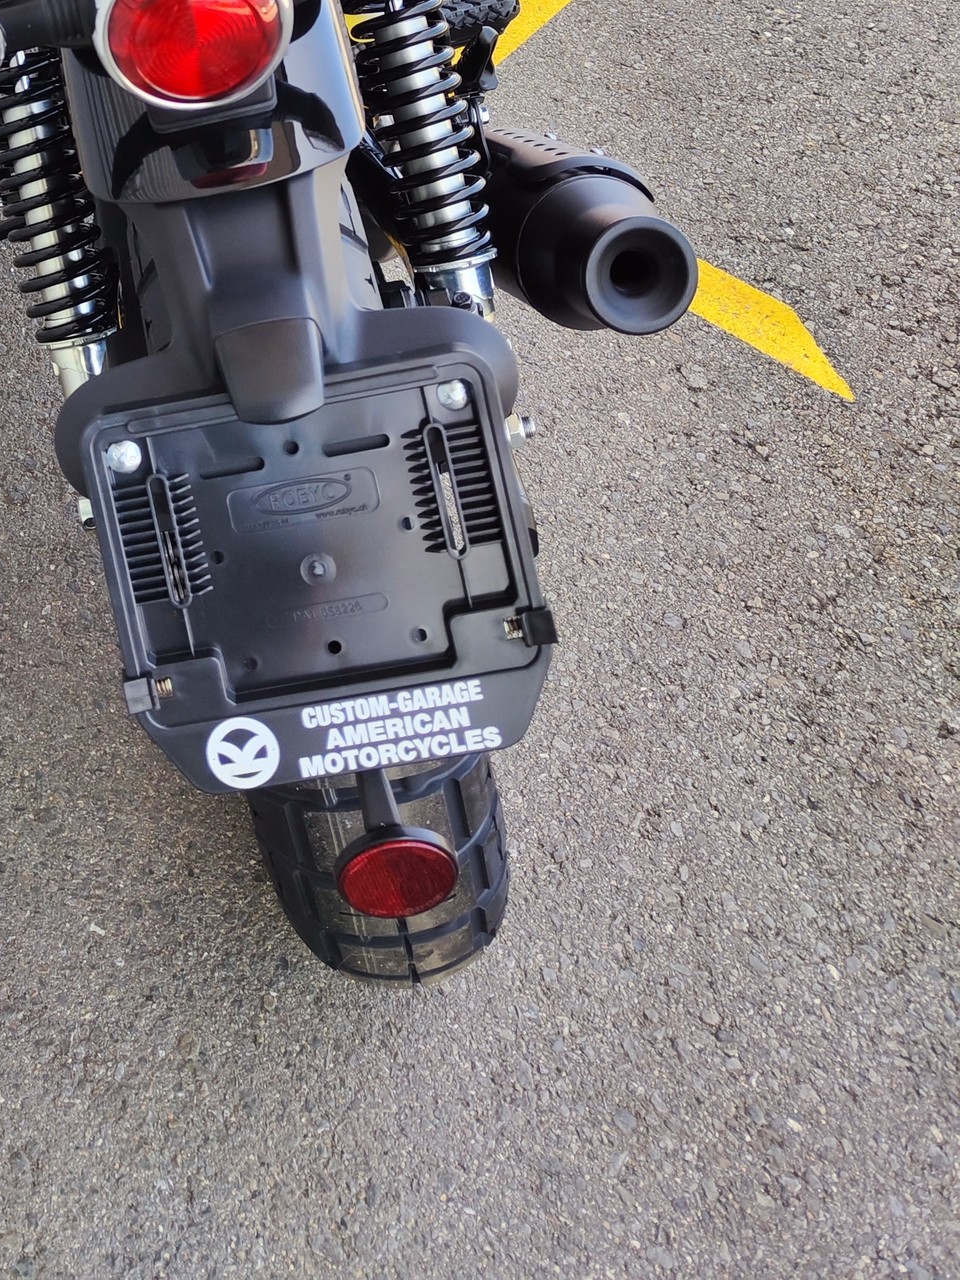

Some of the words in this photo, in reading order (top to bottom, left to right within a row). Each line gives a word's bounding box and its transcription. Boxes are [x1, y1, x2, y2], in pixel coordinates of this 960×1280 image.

[301, 679, 484, 729] CUSTOM-GARAGE
[326, 706, 471, 750] AMERICAN
[298, 726, 503, 778] MOTORCYCLES
